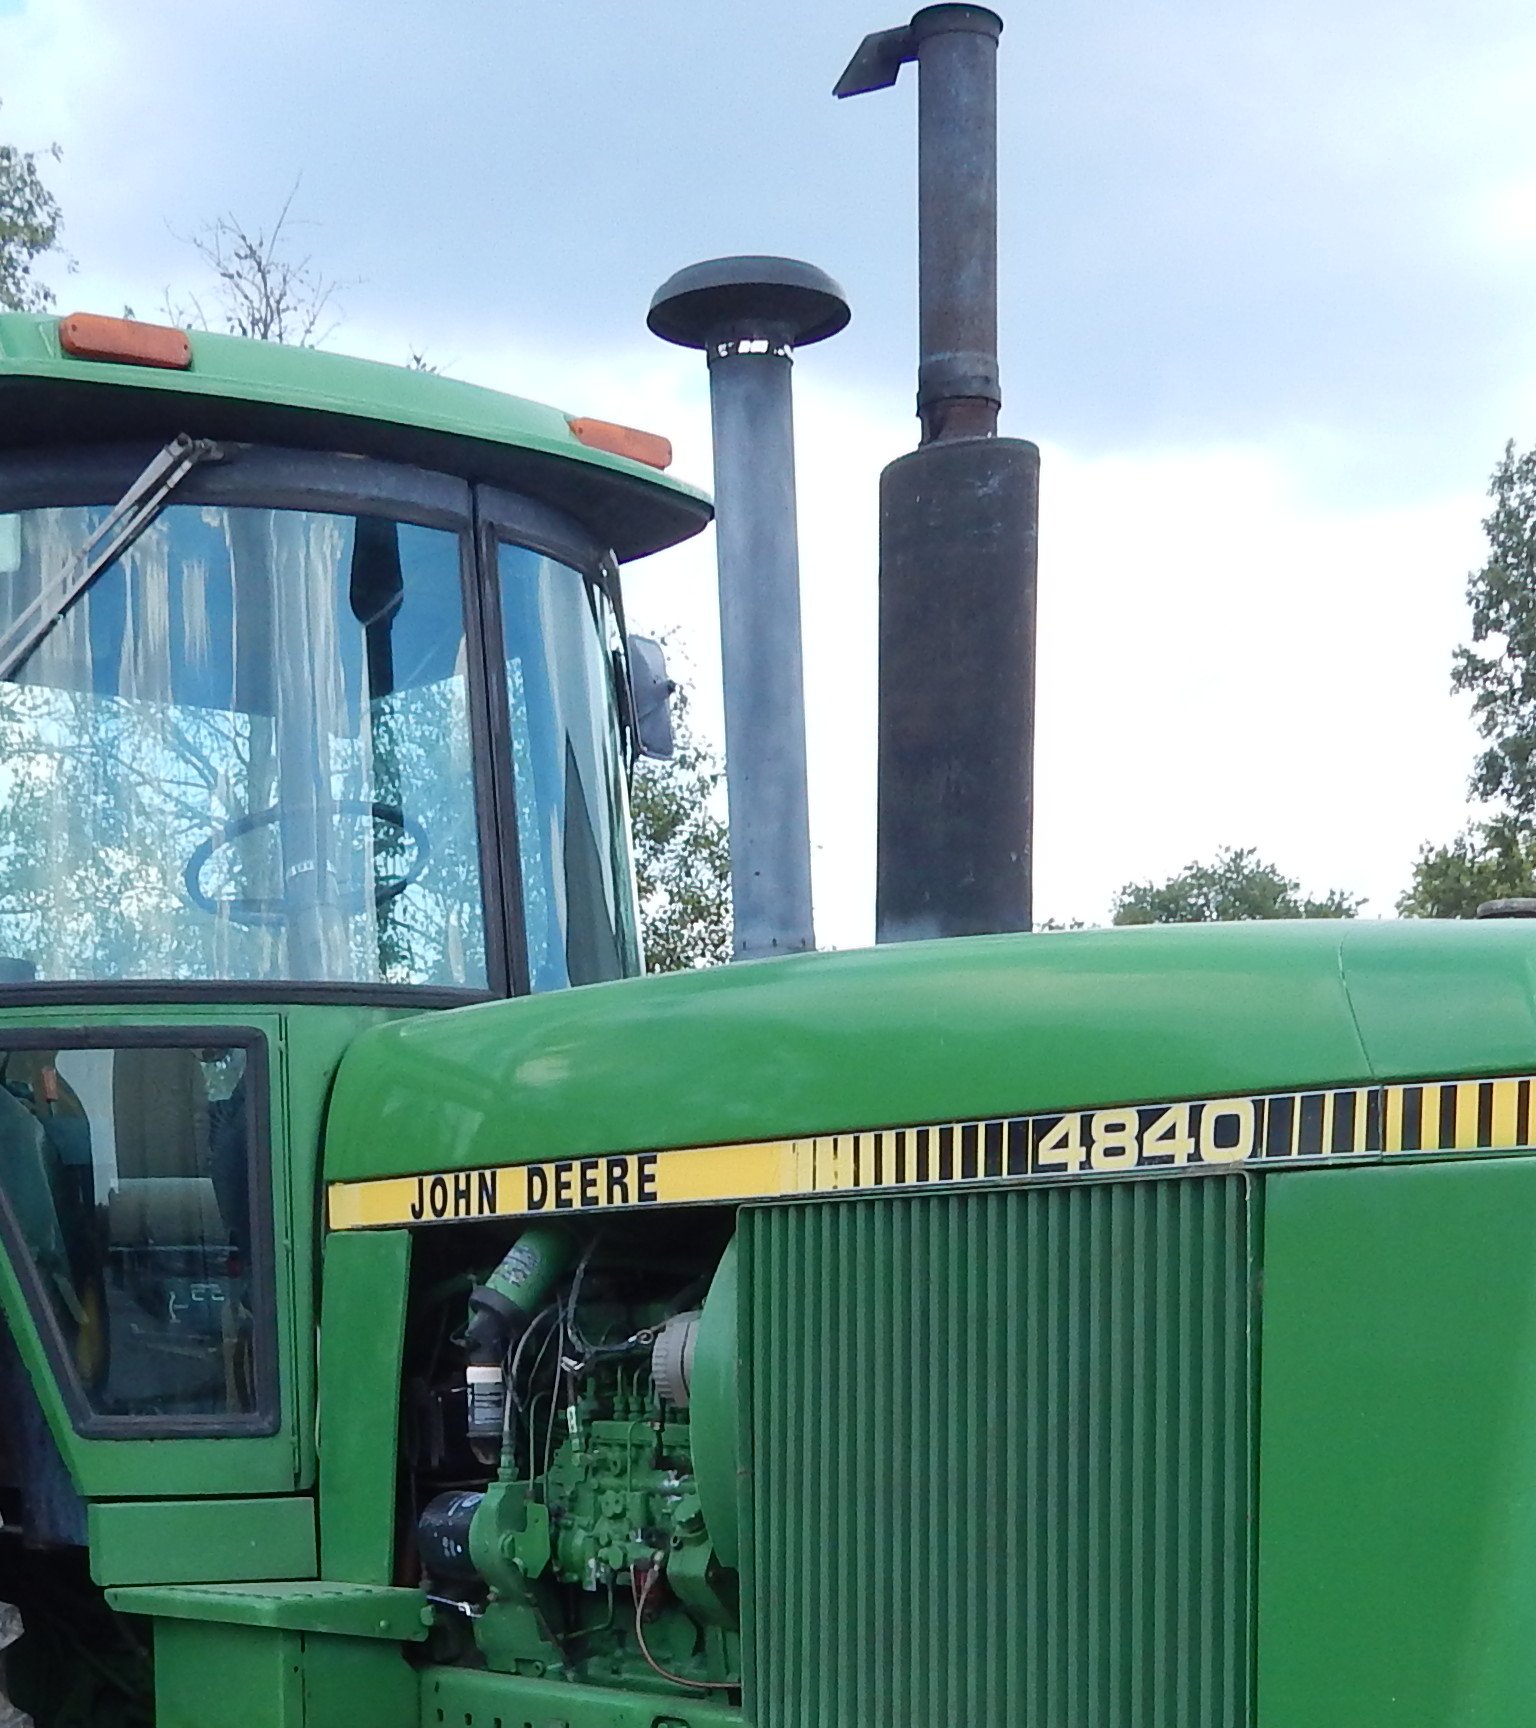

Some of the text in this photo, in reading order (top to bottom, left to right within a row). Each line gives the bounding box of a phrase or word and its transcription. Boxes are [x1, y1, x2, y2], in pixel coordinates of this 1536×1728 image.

[1038, 1100, 1255, 1172] 4840
[411, 1155, 658, 1219] JOHN DEERE
